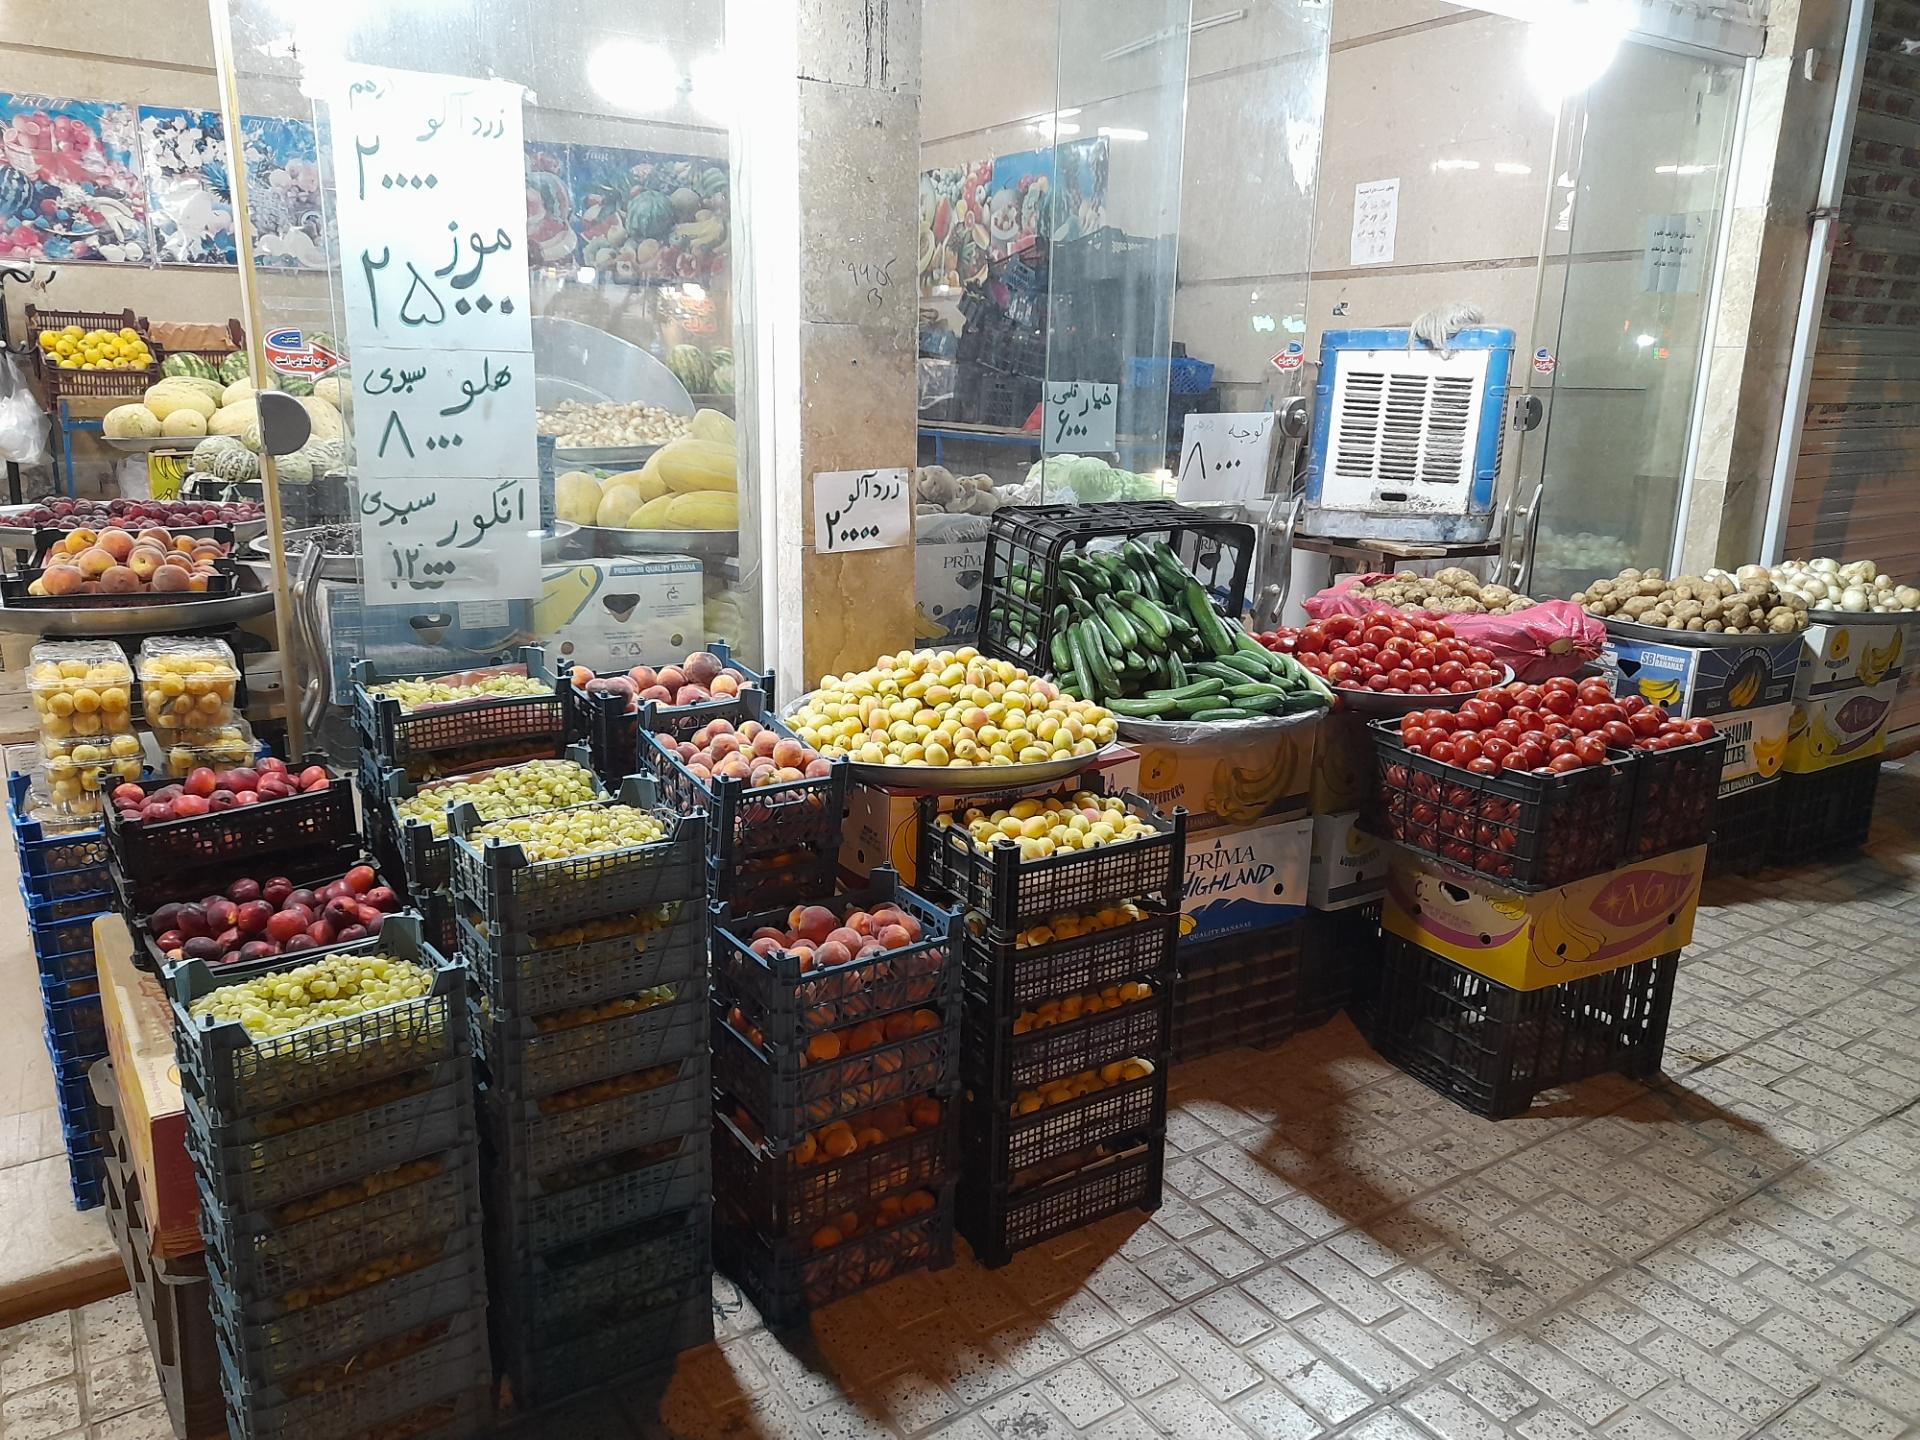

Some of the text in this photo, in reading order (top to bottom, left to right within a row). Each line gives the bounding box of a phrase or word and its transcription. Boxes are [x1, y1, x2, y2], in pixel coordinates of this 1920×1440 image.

[8, 94, 73, 110] FRUIT
[434, 220, 512, 290] موز
[439, 356, 512, 417] هلو
[1078, 384, 1113, 417] خیار
[378, 409, 464, 459] ۸۰۰۰
[1181, 441, 1242, 482] ۸۰۰۰
[435, 479, 524, 549] انگور
[613, 562, 696, 575] PREMIUM QUALITY BANANA
[943, 552, 984, 569] PRIM
[1185, 842, 1257, 874] PRIMA
